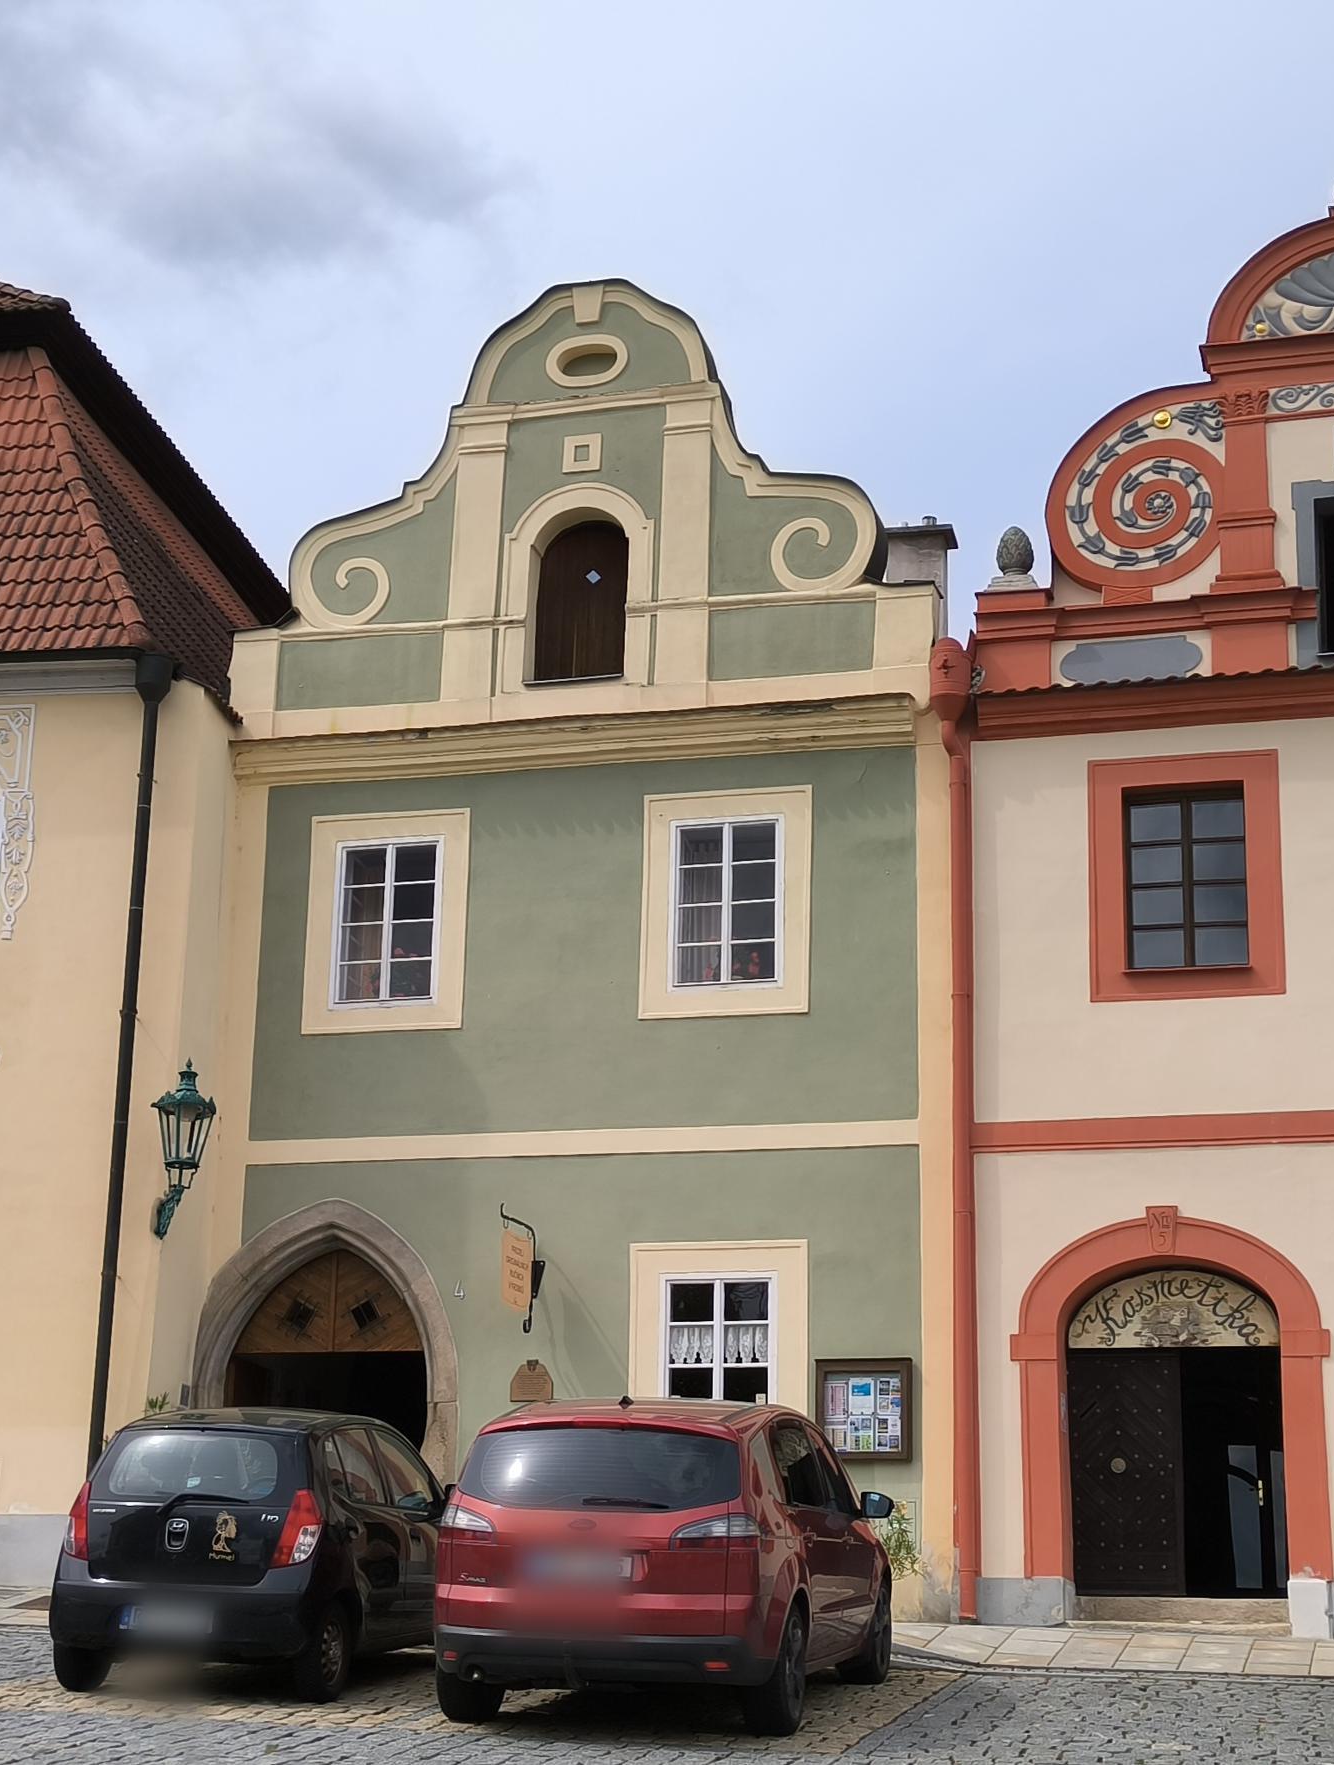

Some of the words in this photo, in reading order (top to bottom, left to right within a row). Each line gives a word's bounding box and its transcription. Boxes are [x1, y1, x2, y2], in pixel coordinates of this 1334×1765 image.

[1158, 1231, 1167, 1247] 5
[454, 1279, 466, 1300] 4
[1076, 1276, 1261, 1347] Kosmetika
